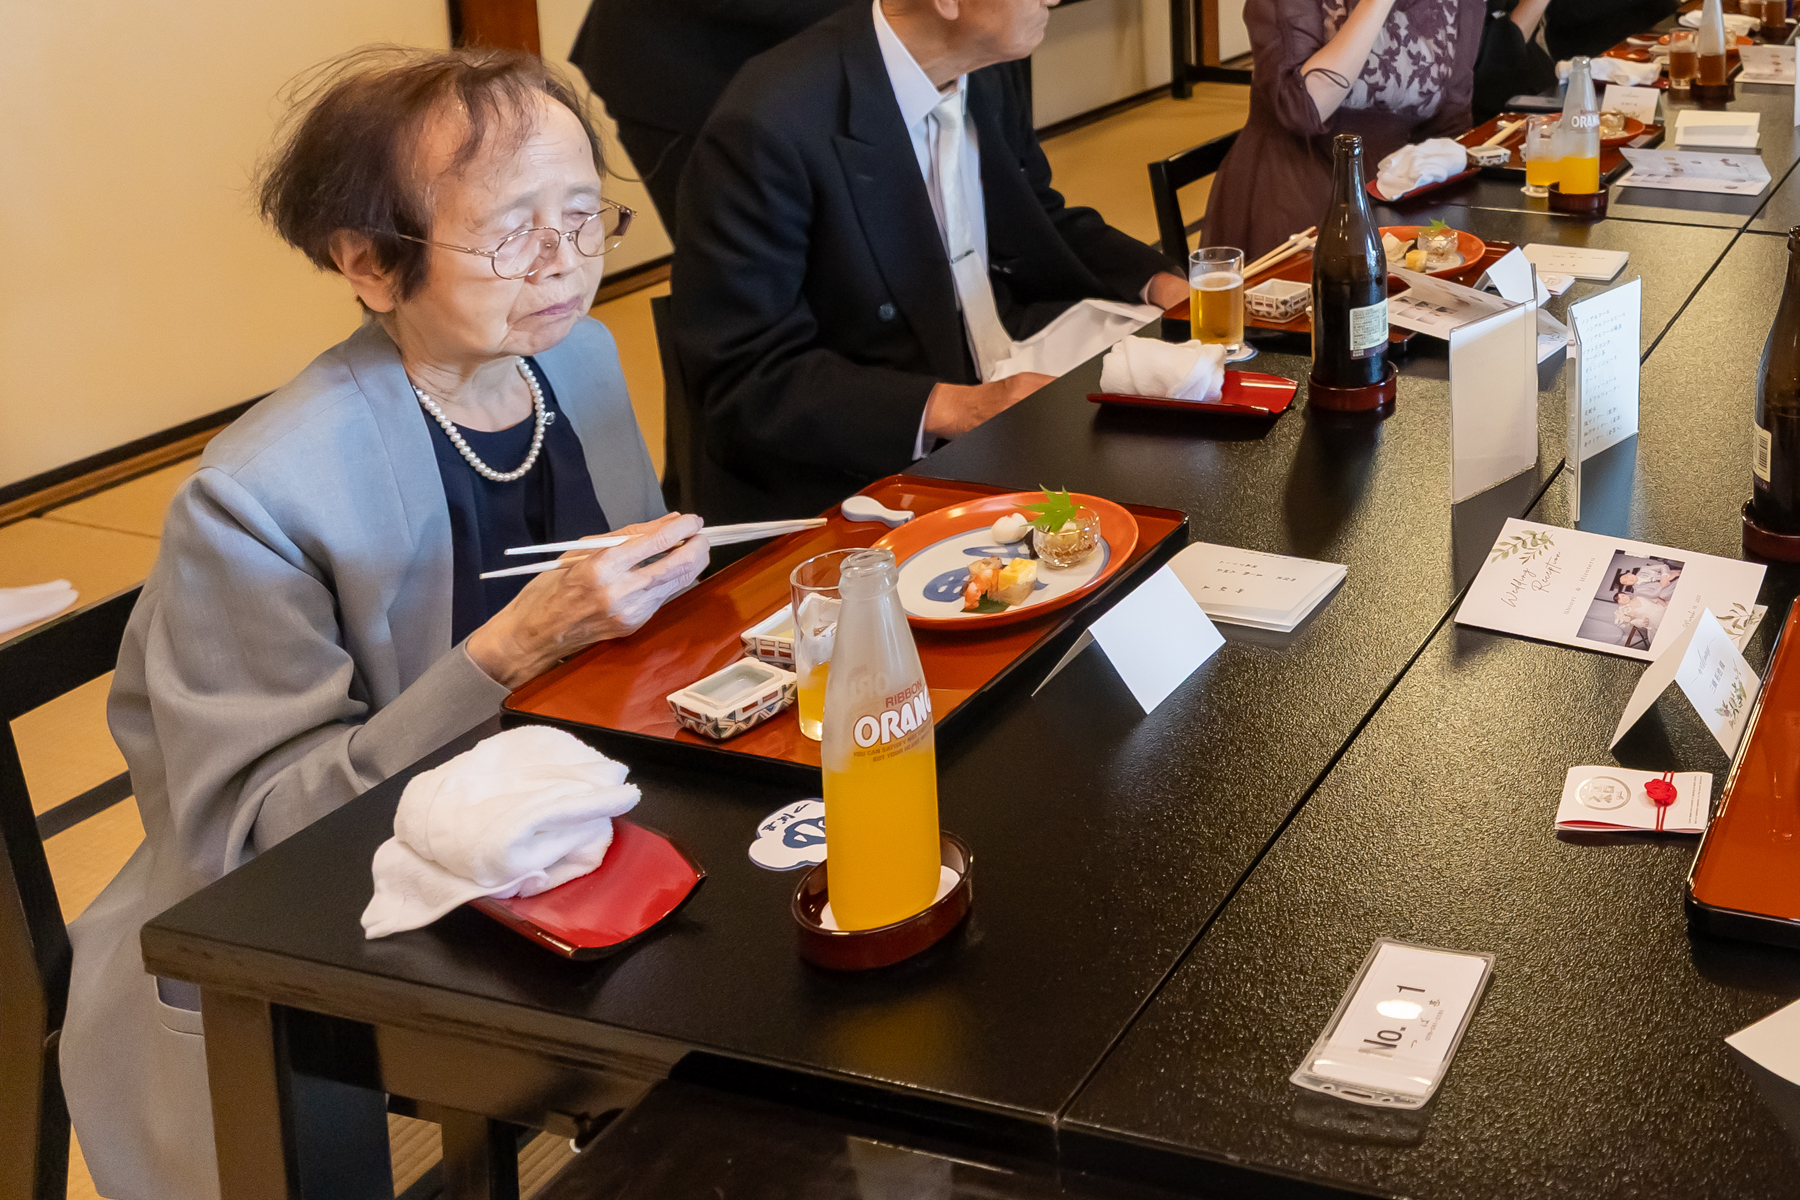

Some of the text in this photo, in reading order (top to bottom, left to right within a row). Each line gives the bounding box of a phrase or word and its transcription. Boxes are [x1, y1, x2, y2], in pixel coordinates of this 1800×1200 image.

[1500, 568, 1537, 608] Wedding
[1531, 552, 1562, 593] Reception
[885, 678, 922, 708] RIBBON
[1358, 985, 1426, 1058] No. 1
